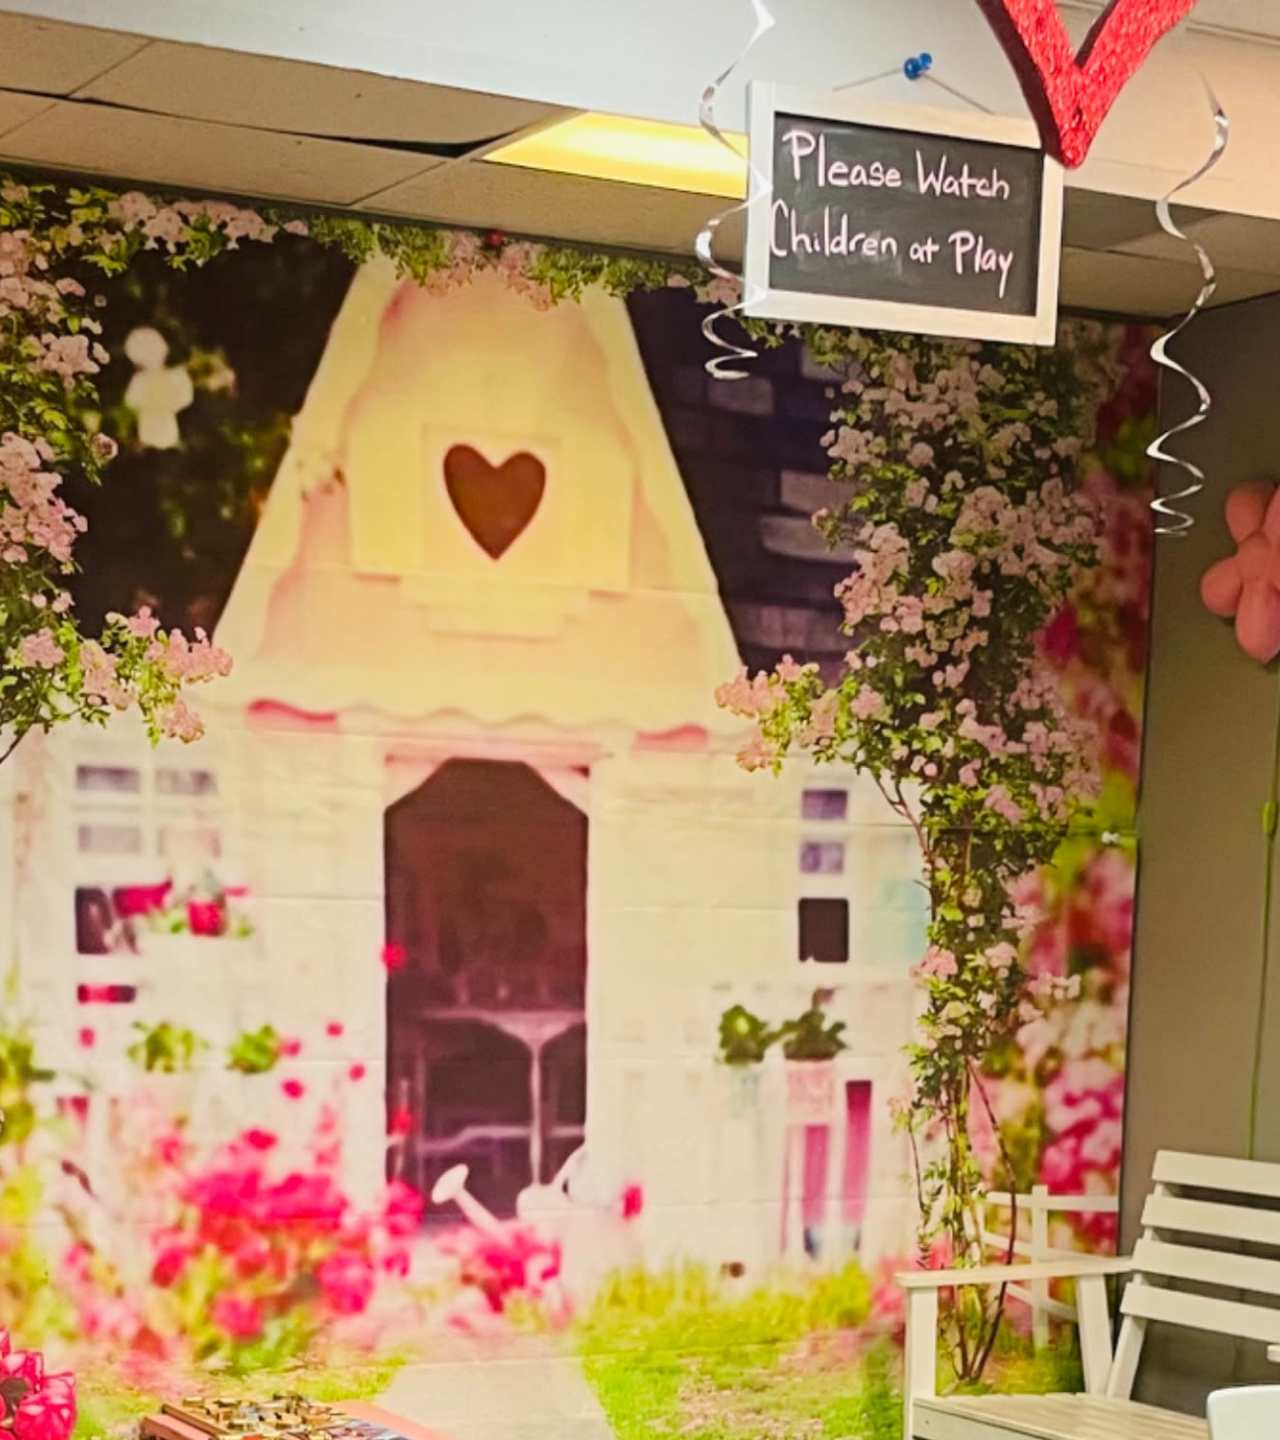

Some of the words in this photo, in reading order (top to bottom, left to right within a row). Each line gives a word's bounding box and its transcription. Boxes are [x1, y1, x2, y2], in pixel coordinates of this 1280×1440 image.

[781, 128, 903, 188] Please
[915, 150, 1011, 201] Watch
[769, 198, 898, 258] Children
[909, 236, 940, 264] at
[947, 230, 1015, 299] Play
